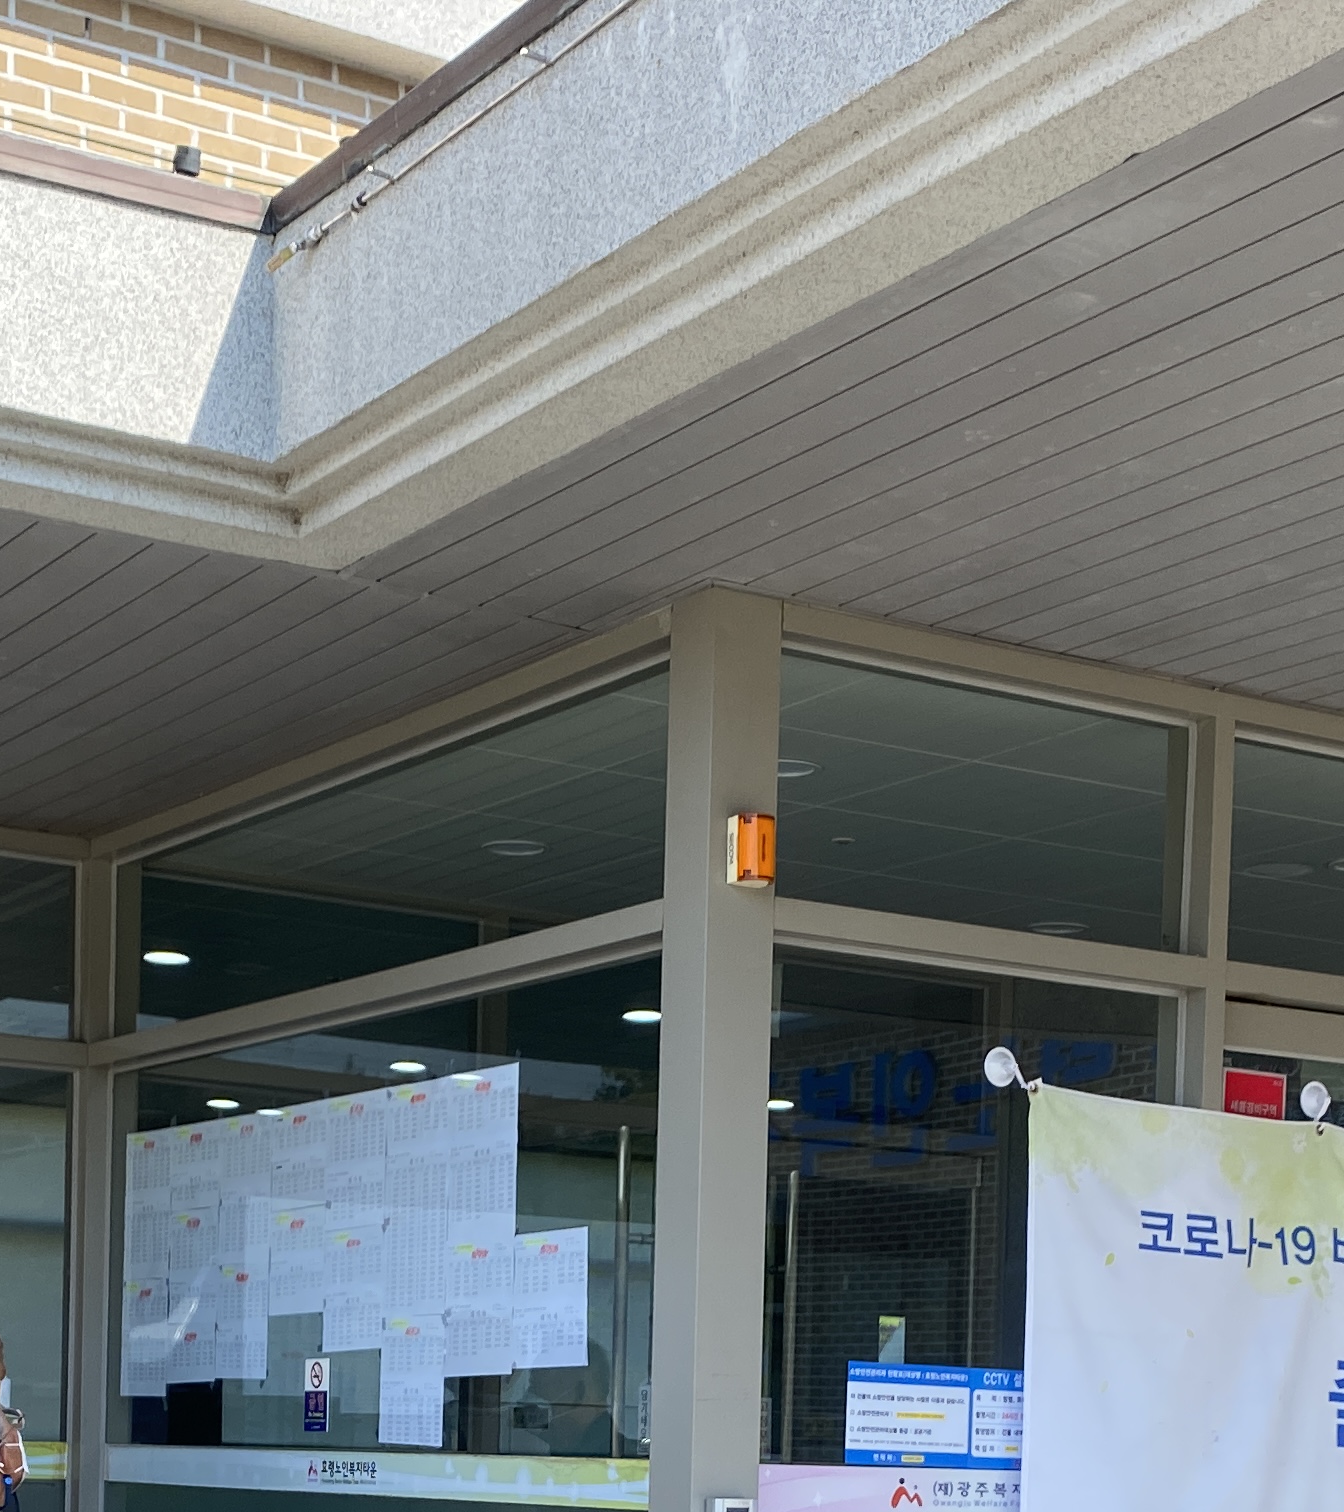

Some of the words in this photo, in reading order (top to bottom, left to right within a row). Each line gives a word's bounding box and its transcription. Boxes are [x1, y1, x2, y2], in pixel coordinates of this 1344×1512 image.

[1138, 1208, 1317, 1267] 코로나-19
[983, 1371, 1011, 1386] CCTV
[1014, 1372, 1023, 1388] 설
[321, 1460, 377, 1478] 효령노인복지타운
